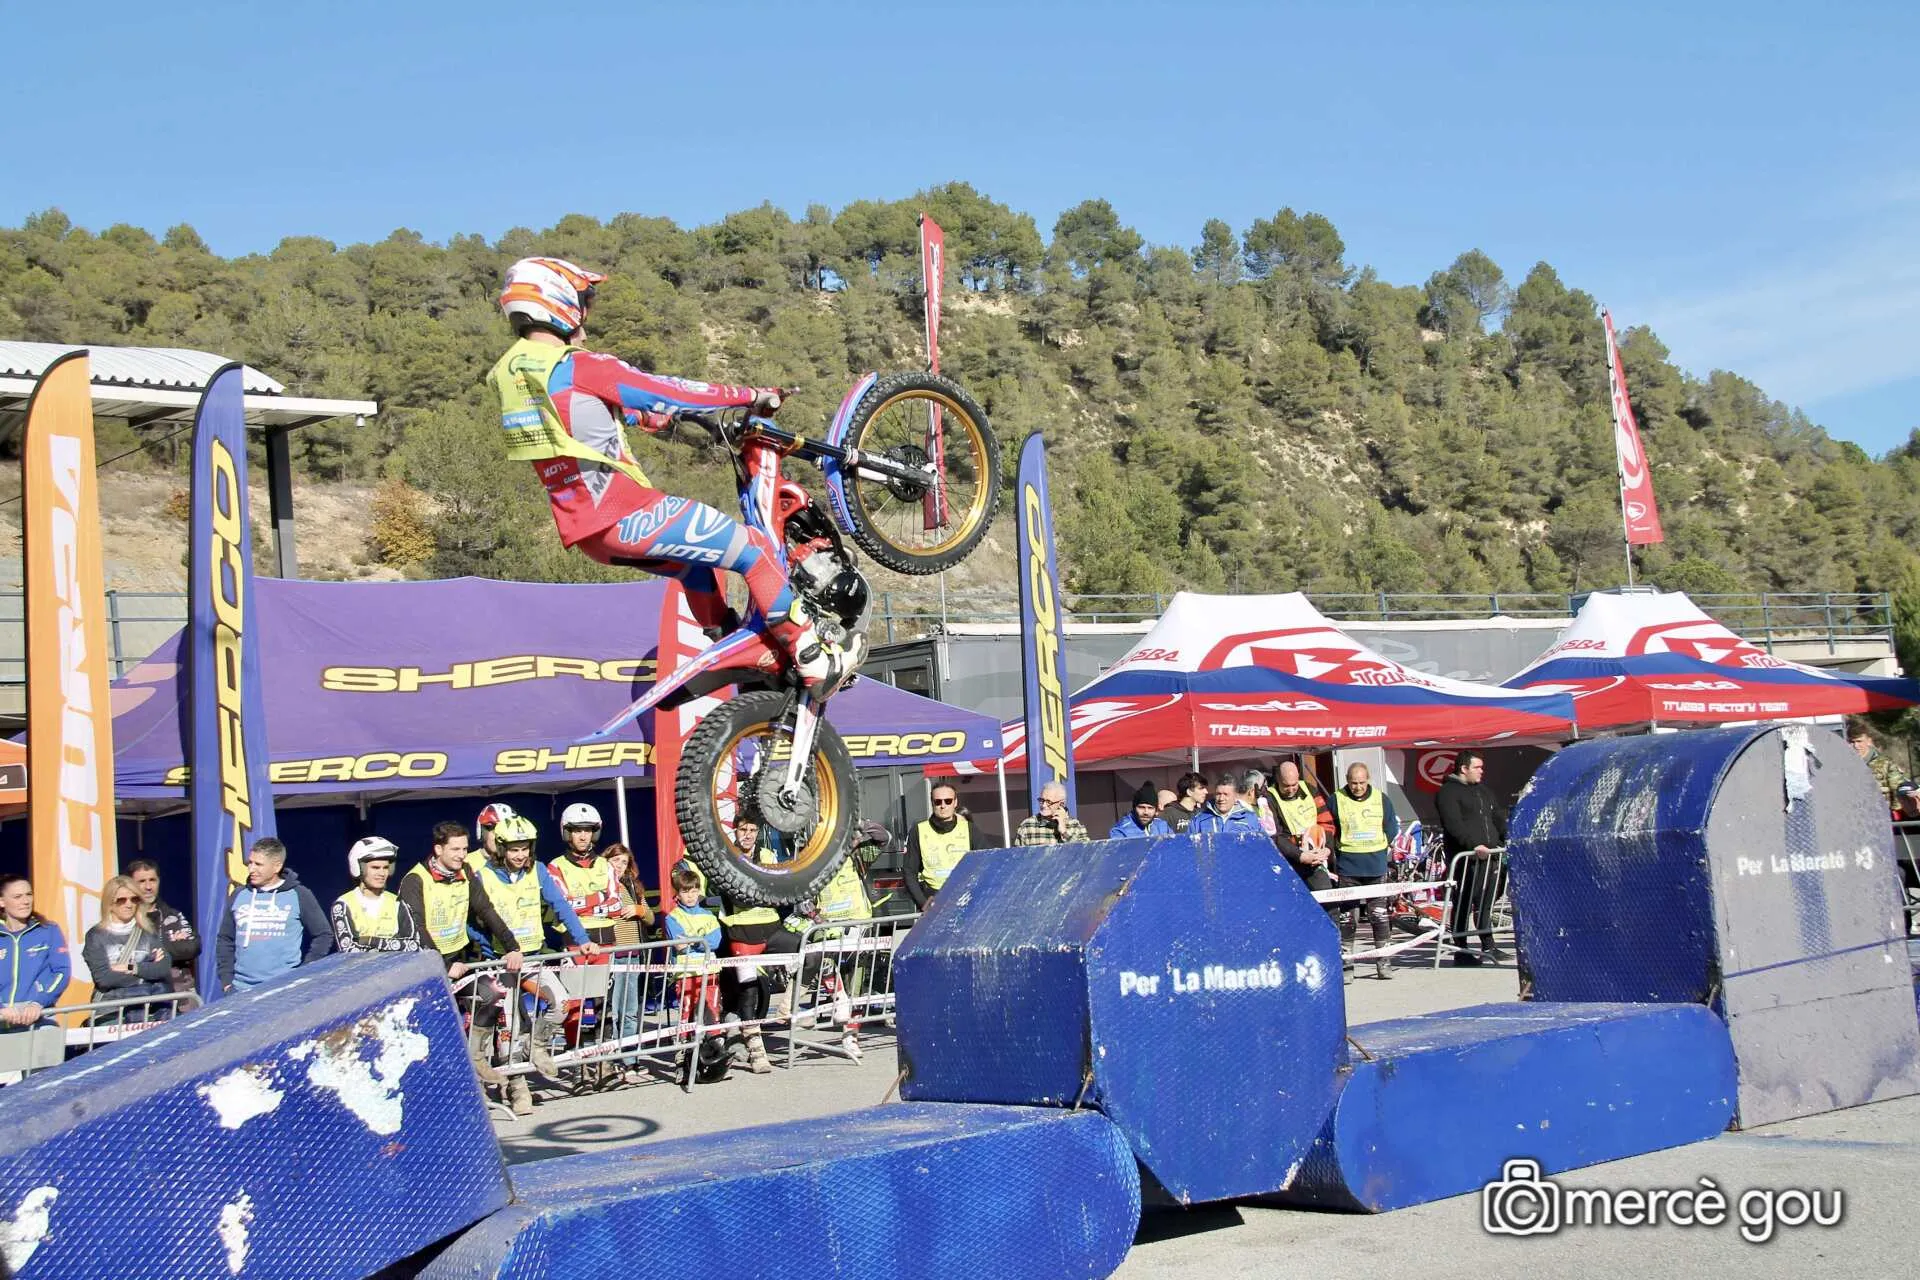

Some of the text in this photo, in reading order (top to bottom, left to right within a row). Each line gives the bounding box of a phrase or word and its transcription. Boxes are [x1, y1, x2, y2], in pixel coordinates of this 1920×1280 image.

[644, 543, 727, 563] MOTS
[1027, 484, 1069, 783] HERCO
[211, 437, 252, 897] HERCO
[323, 655, 657, 693] SHERC
[164, 752, 449, 785] SERCO
[495, 742, 657, 774] SHER
[1737, 855, 1764, 876] Per
[1119, 970, 1161, 997] Per
